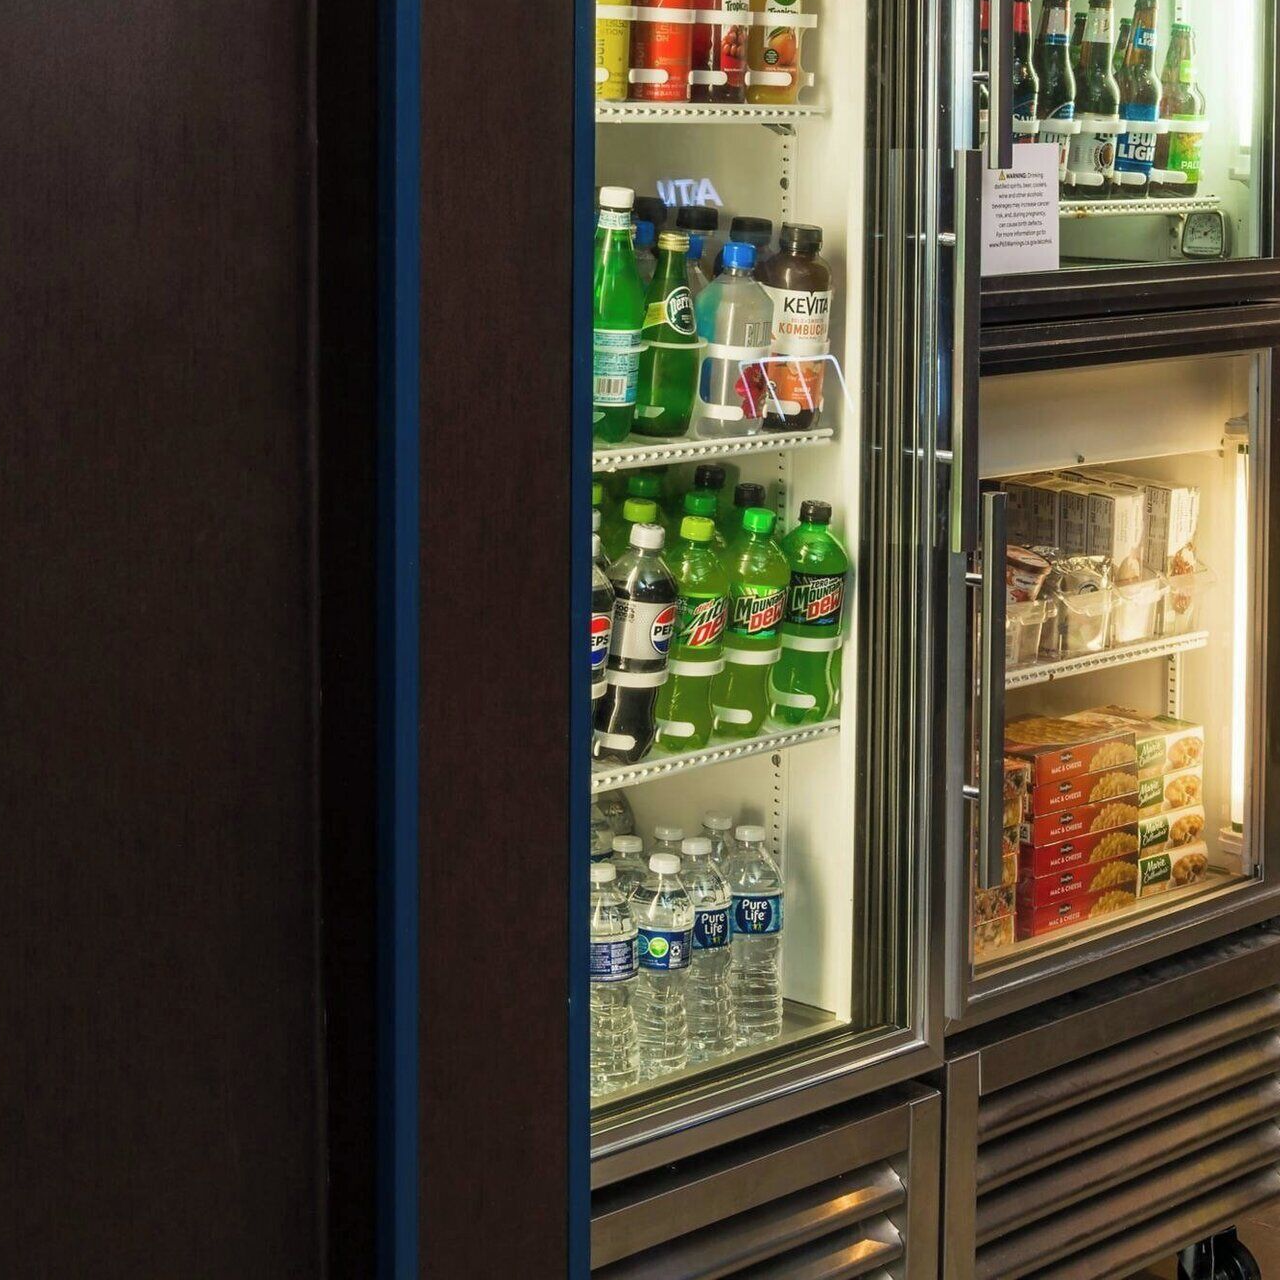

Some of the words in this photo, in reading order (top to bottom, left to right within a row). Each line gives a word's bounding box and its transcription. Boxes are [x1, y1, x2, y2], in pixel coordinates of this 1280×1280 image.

[1117, 145, 1156, 161] LIGH
[778, 322, 825, 337] KOMBUC
[592, 634, 609, 647] EPS
[742, 899, 768, 911] Pure
[701, 912, 725, 924] Pure
[745, 910, 765, 922] Life
[704, 923, 723, 936] Life
